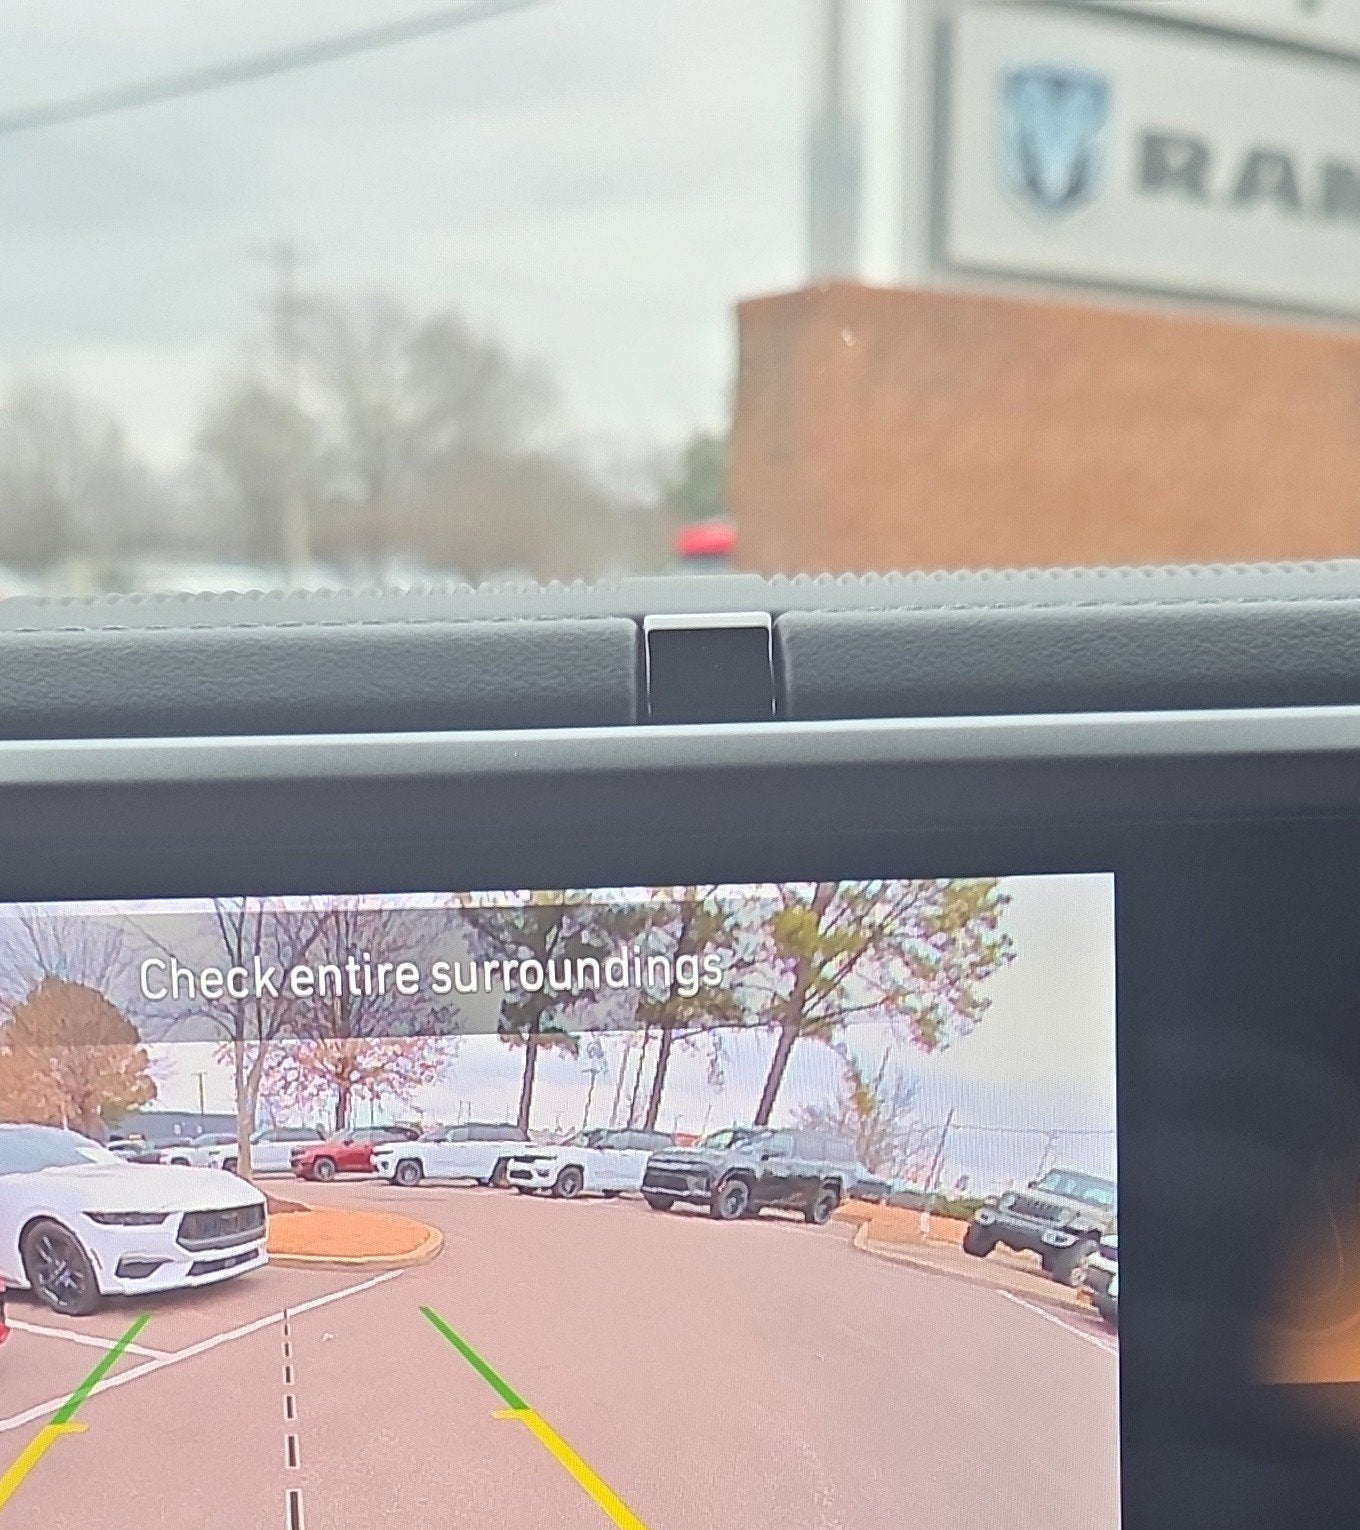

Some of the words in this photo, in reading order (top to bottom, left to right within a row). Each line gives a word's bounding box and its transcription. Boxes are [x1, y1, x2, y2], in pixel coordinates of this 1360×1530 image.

[140, 957, 291, 1000] Check
[290, 952, 420, 996] entire
[432, 946, 724, 998] surroundings
